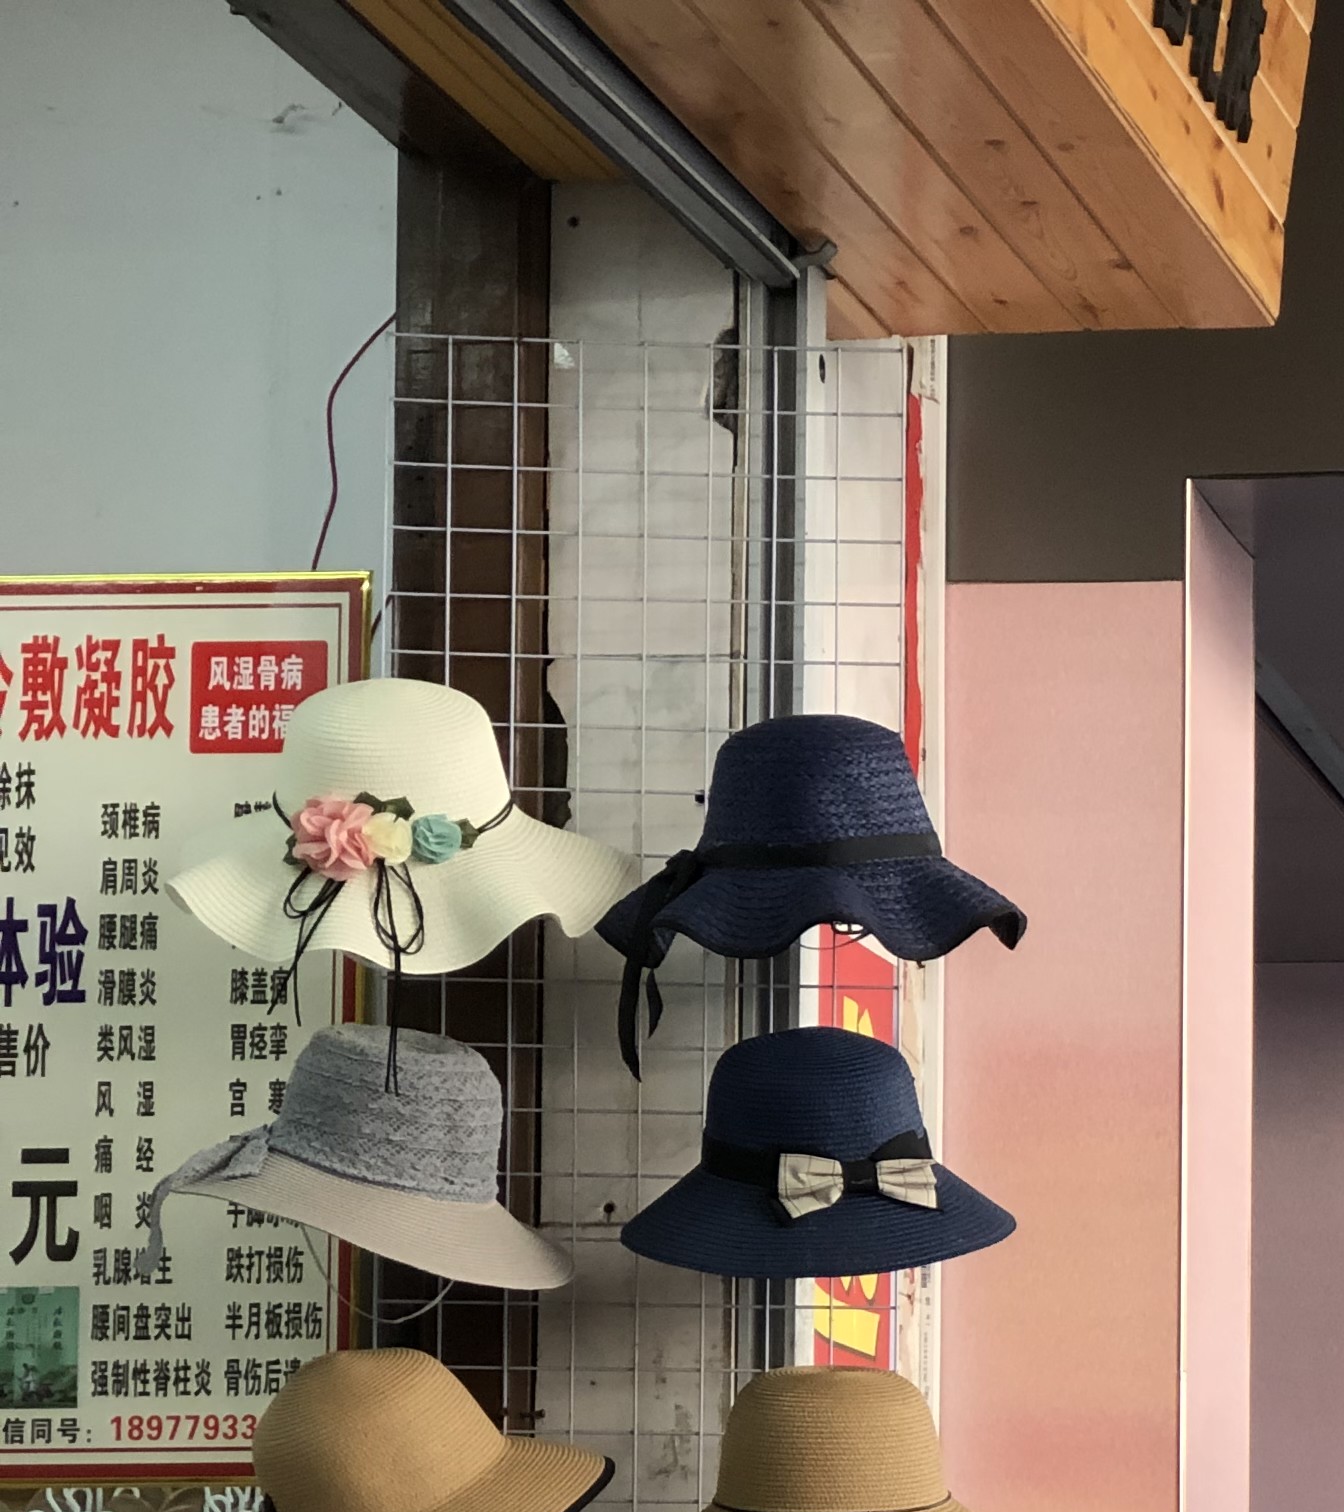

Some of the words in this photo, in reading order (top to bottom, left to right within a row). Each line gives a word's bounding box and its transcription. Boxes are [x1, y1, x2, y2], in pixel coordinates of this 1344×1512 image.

[0, 634, 176, 742] 敷凝胶
[208, 654, 304, 691] 风湿骨病
[100, 802, 161, 839] 颈椎病
[100, 857, 160, 896] 肩周炎
[98, 912, 159, 951] 腰腿痛
[97, 968, 157, 1006] 滑膜炎
[97, 1024, 156, 1062] 类风湿
[9, 1147, 81, 1265] 元
[225, 1246, 304, 1284] 跌打损伤
[90, 1302, 192, 1341] 腰间盘突出
[224, 1301, 323, 1340] 半月板损伤
[90, 1358, 212, 1397] 强制性脊柱炎
